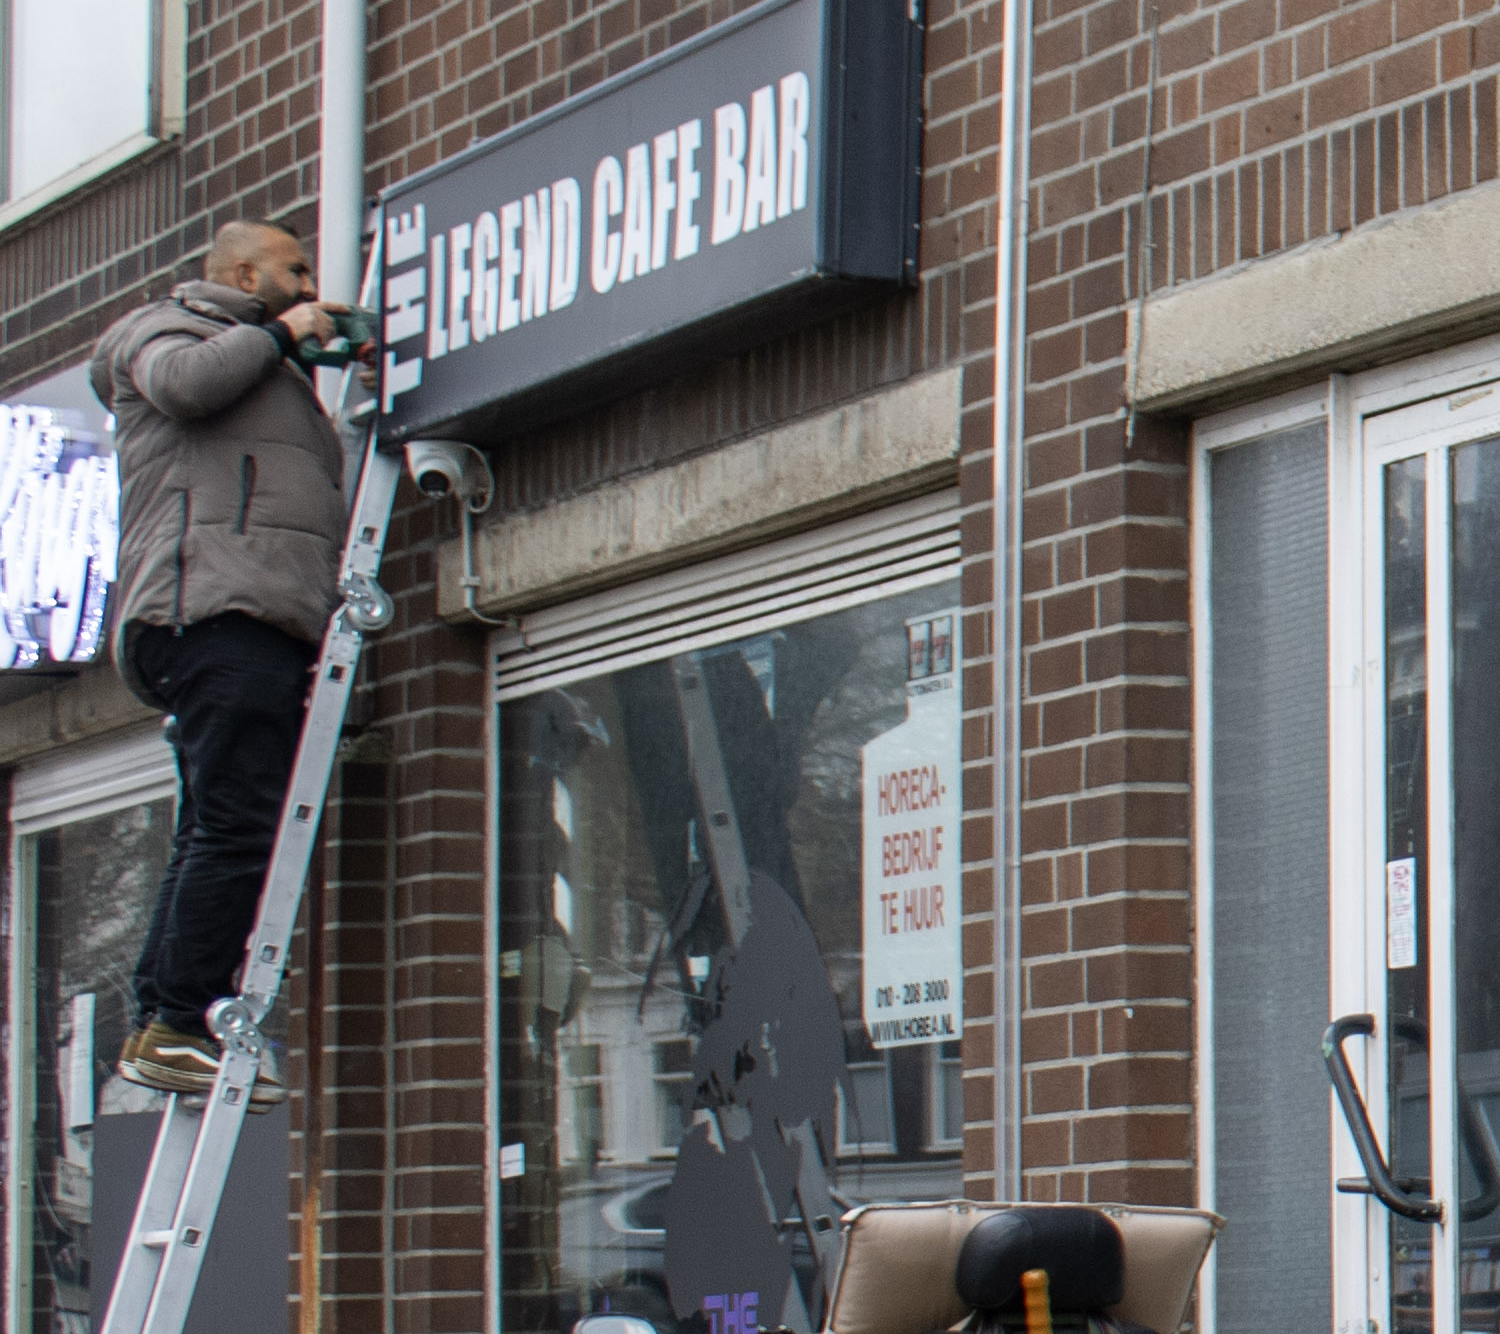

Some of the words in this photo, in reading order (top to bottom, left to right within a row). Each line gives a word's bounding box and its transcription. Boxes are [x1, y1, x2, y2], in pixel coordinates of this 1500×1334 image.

[427, 175, 582, 361] LEGEND
[590, 117, 703, 294] CAFE
[711, 69, 811, 246] BAR
[384, 203, 426, 414] THE
[878, 764, 947, 818] HORECA-
[883, 825, 944, 878] BEDRIJF
[880, 891, 900, 935] TE
[903, 884, 946, 931] HUUR
